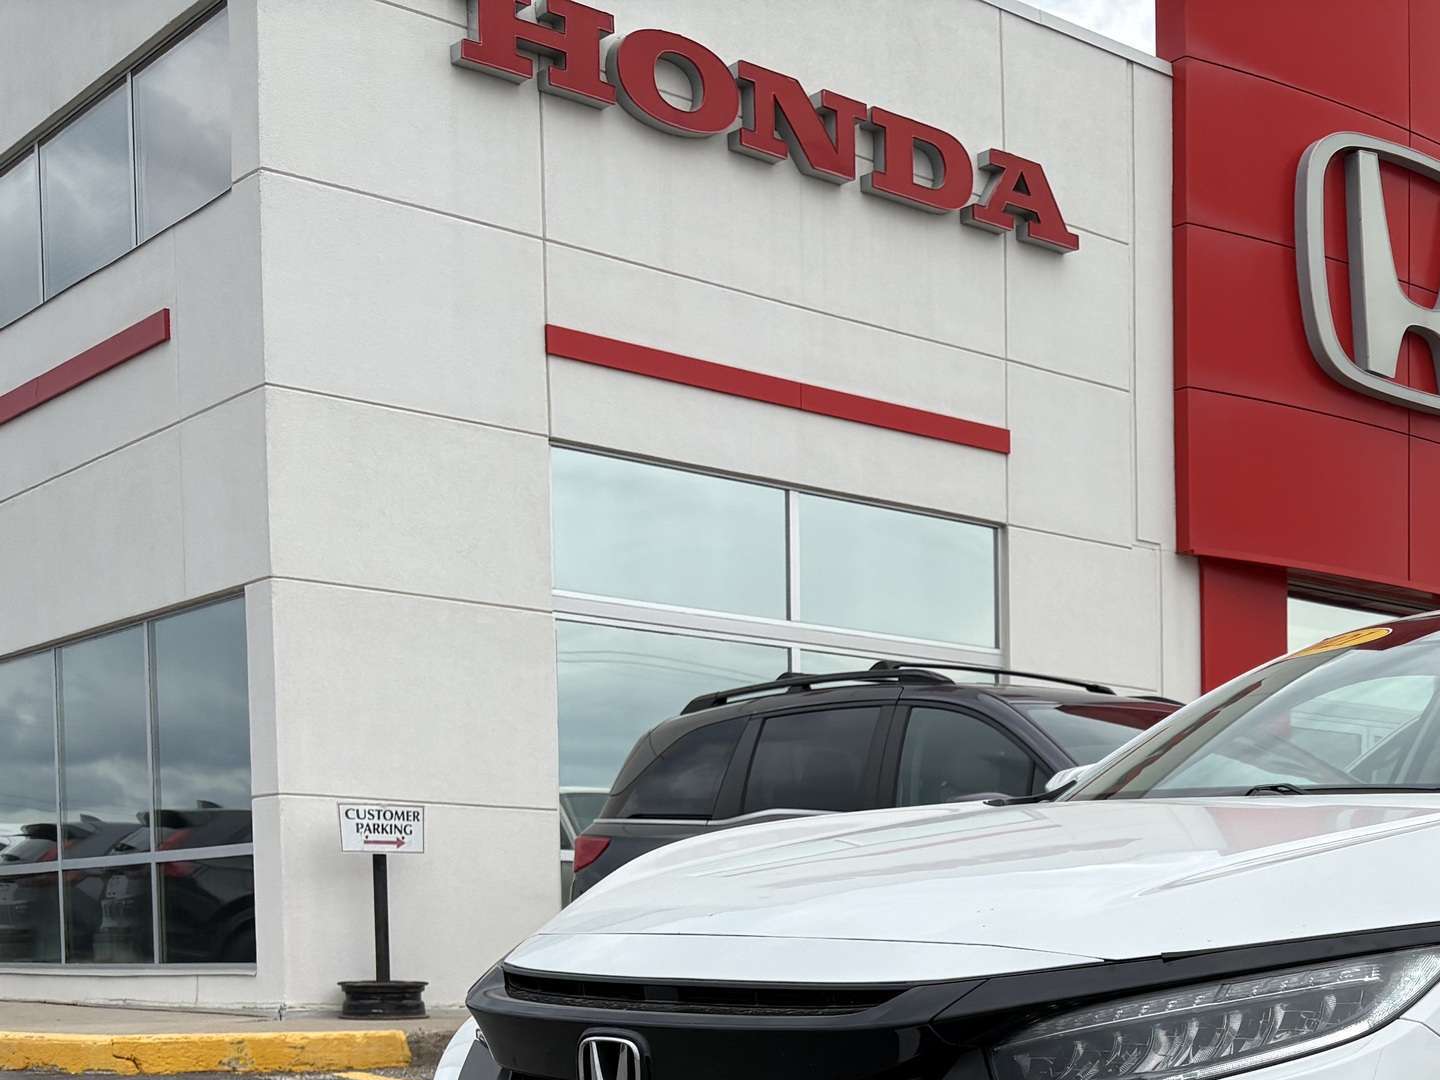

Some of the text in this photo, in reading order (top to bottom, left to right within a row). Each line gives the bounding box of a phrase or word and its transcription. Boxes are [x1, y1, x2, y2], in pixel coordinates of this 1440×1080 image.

[451, 0, 1079, 253] HONDA
[344, 808, 420, 822] CUSTOMER
[356, 822, 413, 835] PARKING
